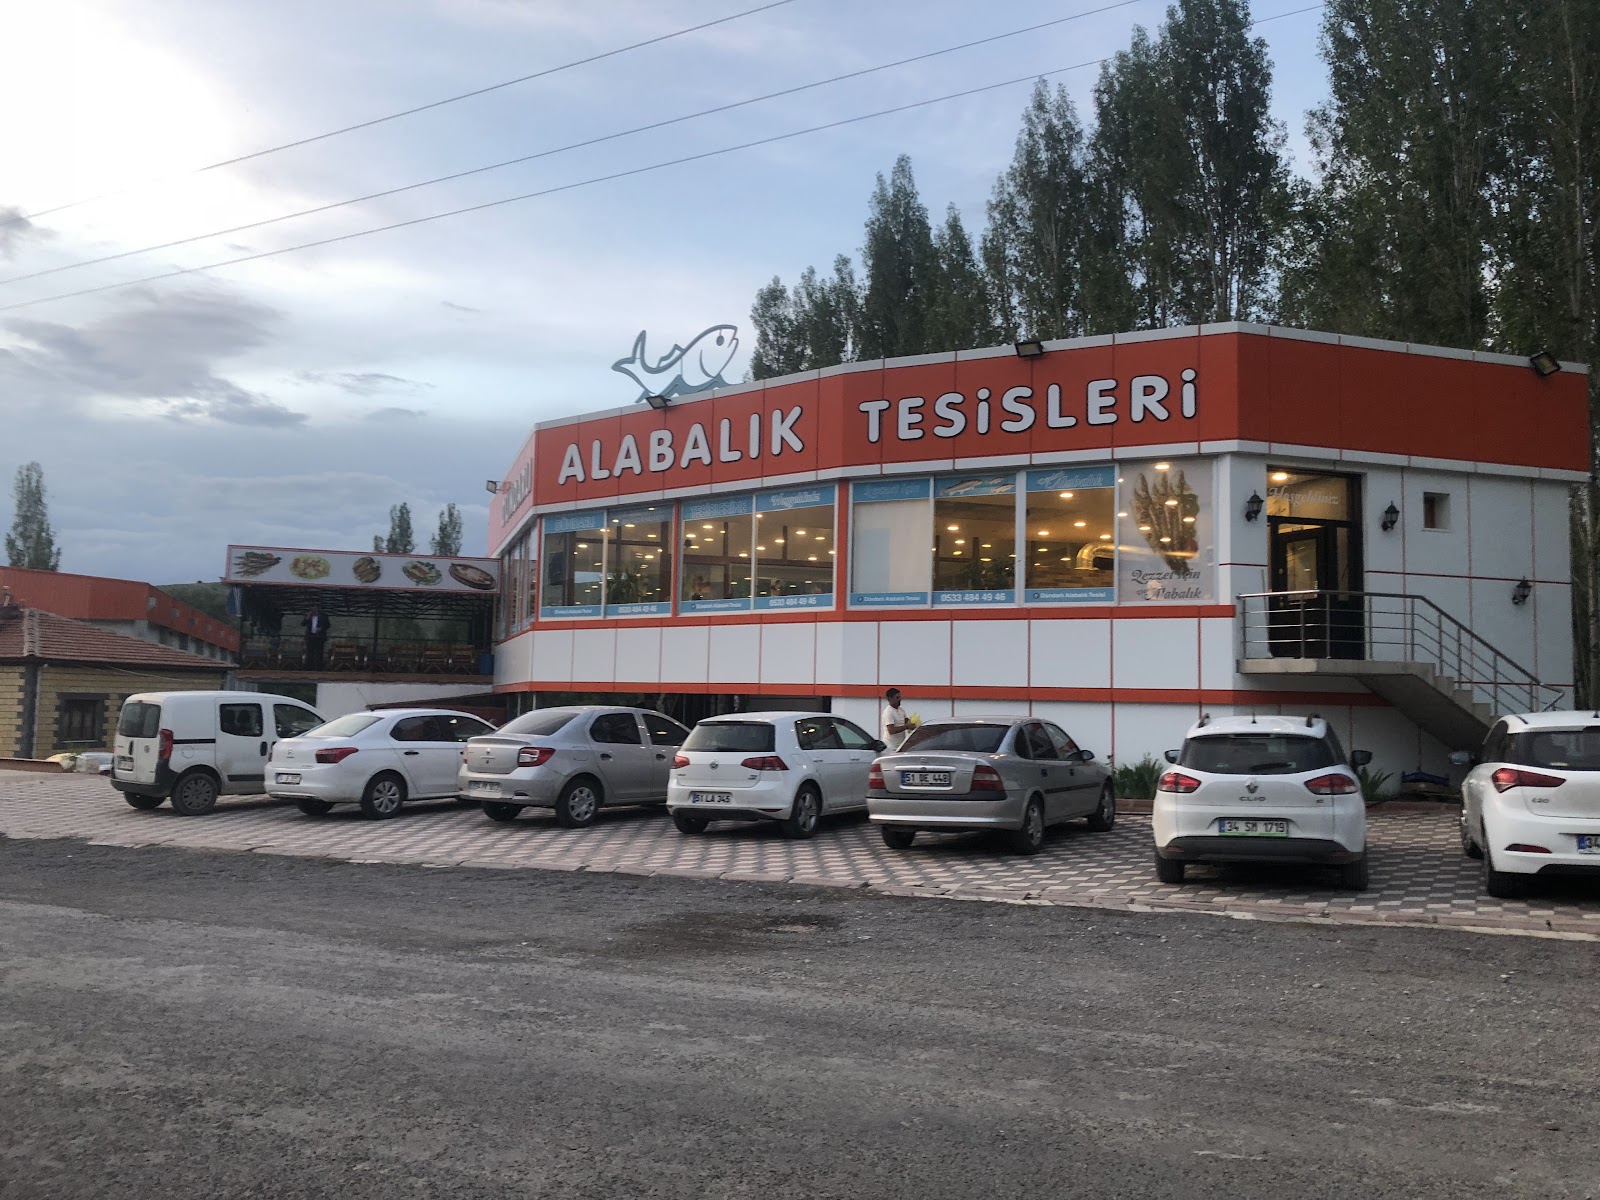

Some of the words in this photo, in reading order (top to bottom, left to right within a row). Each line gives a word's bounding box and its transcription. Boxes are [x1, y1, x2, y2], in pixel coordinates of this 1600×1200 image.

[557, 405, 804, 485] ALABALIK
[940, 593, 962, 602] 0533
[1227, 821, 1239, 832] 34
